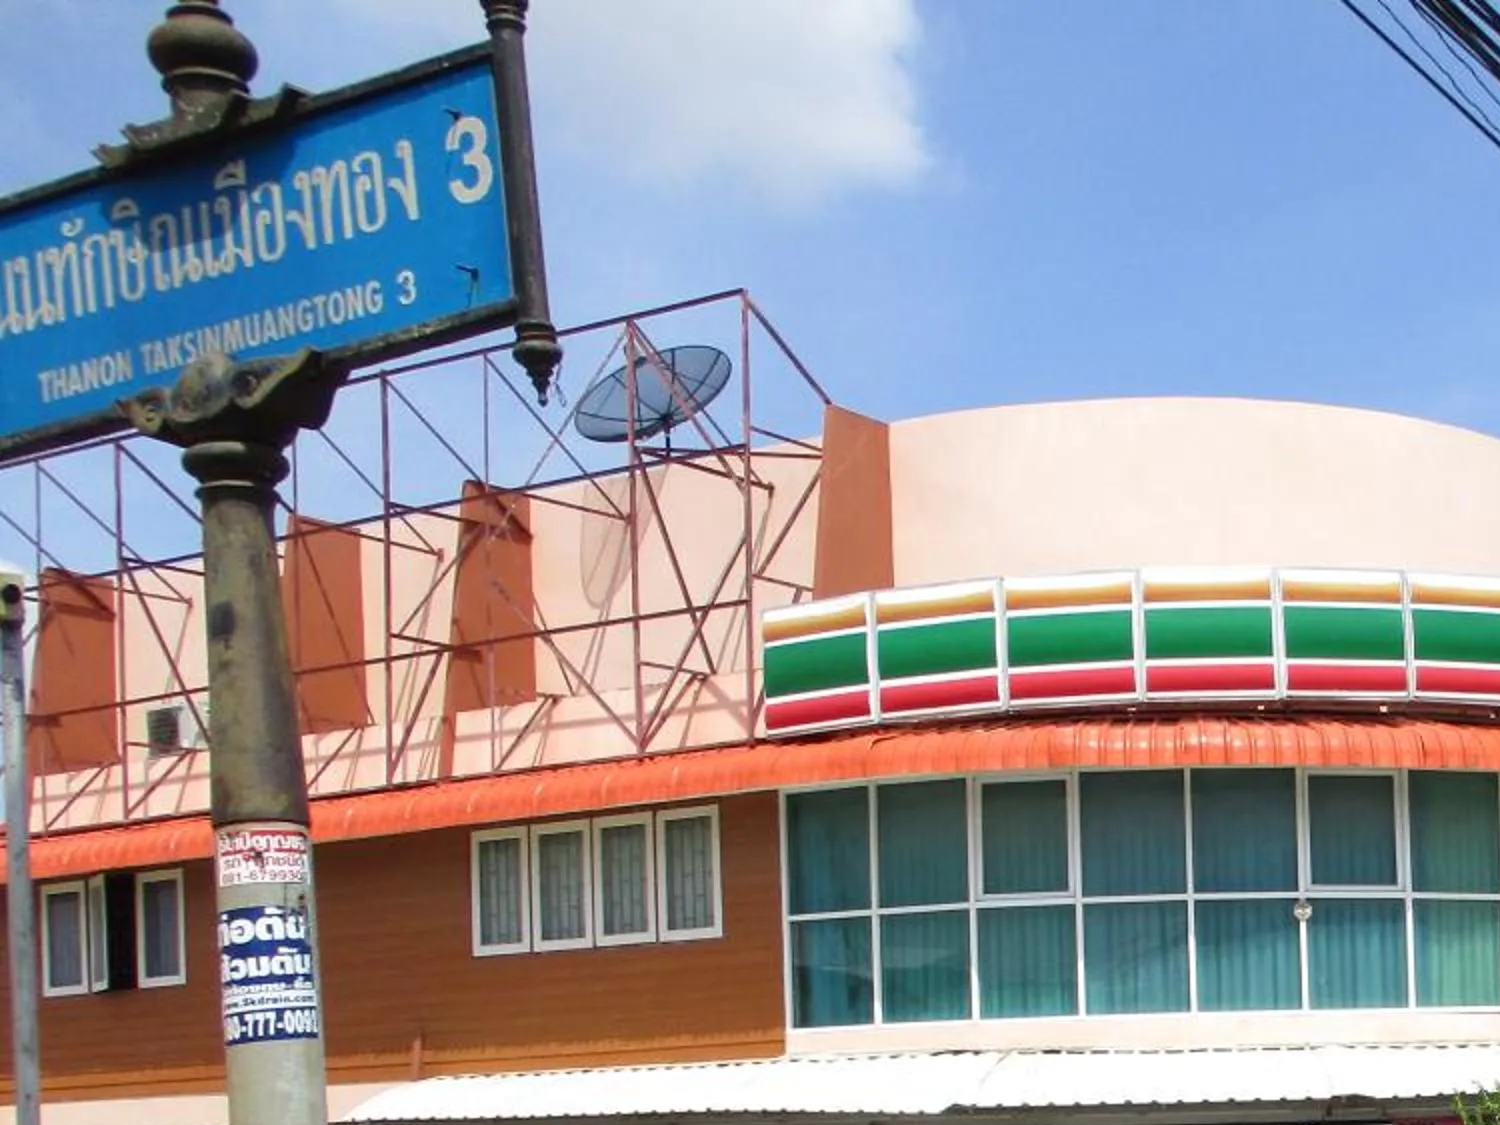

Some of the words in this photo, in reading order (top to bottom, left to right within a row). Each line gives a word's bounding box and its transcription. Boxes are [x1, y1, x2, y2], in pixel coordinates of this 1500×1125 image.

[445, 115, 494, 205] 3
[37, 352, 133, 404] THANON
[139, 280, 384, 375] TAKSINMUANGTONG
[396, 269, 417, 305] 3
